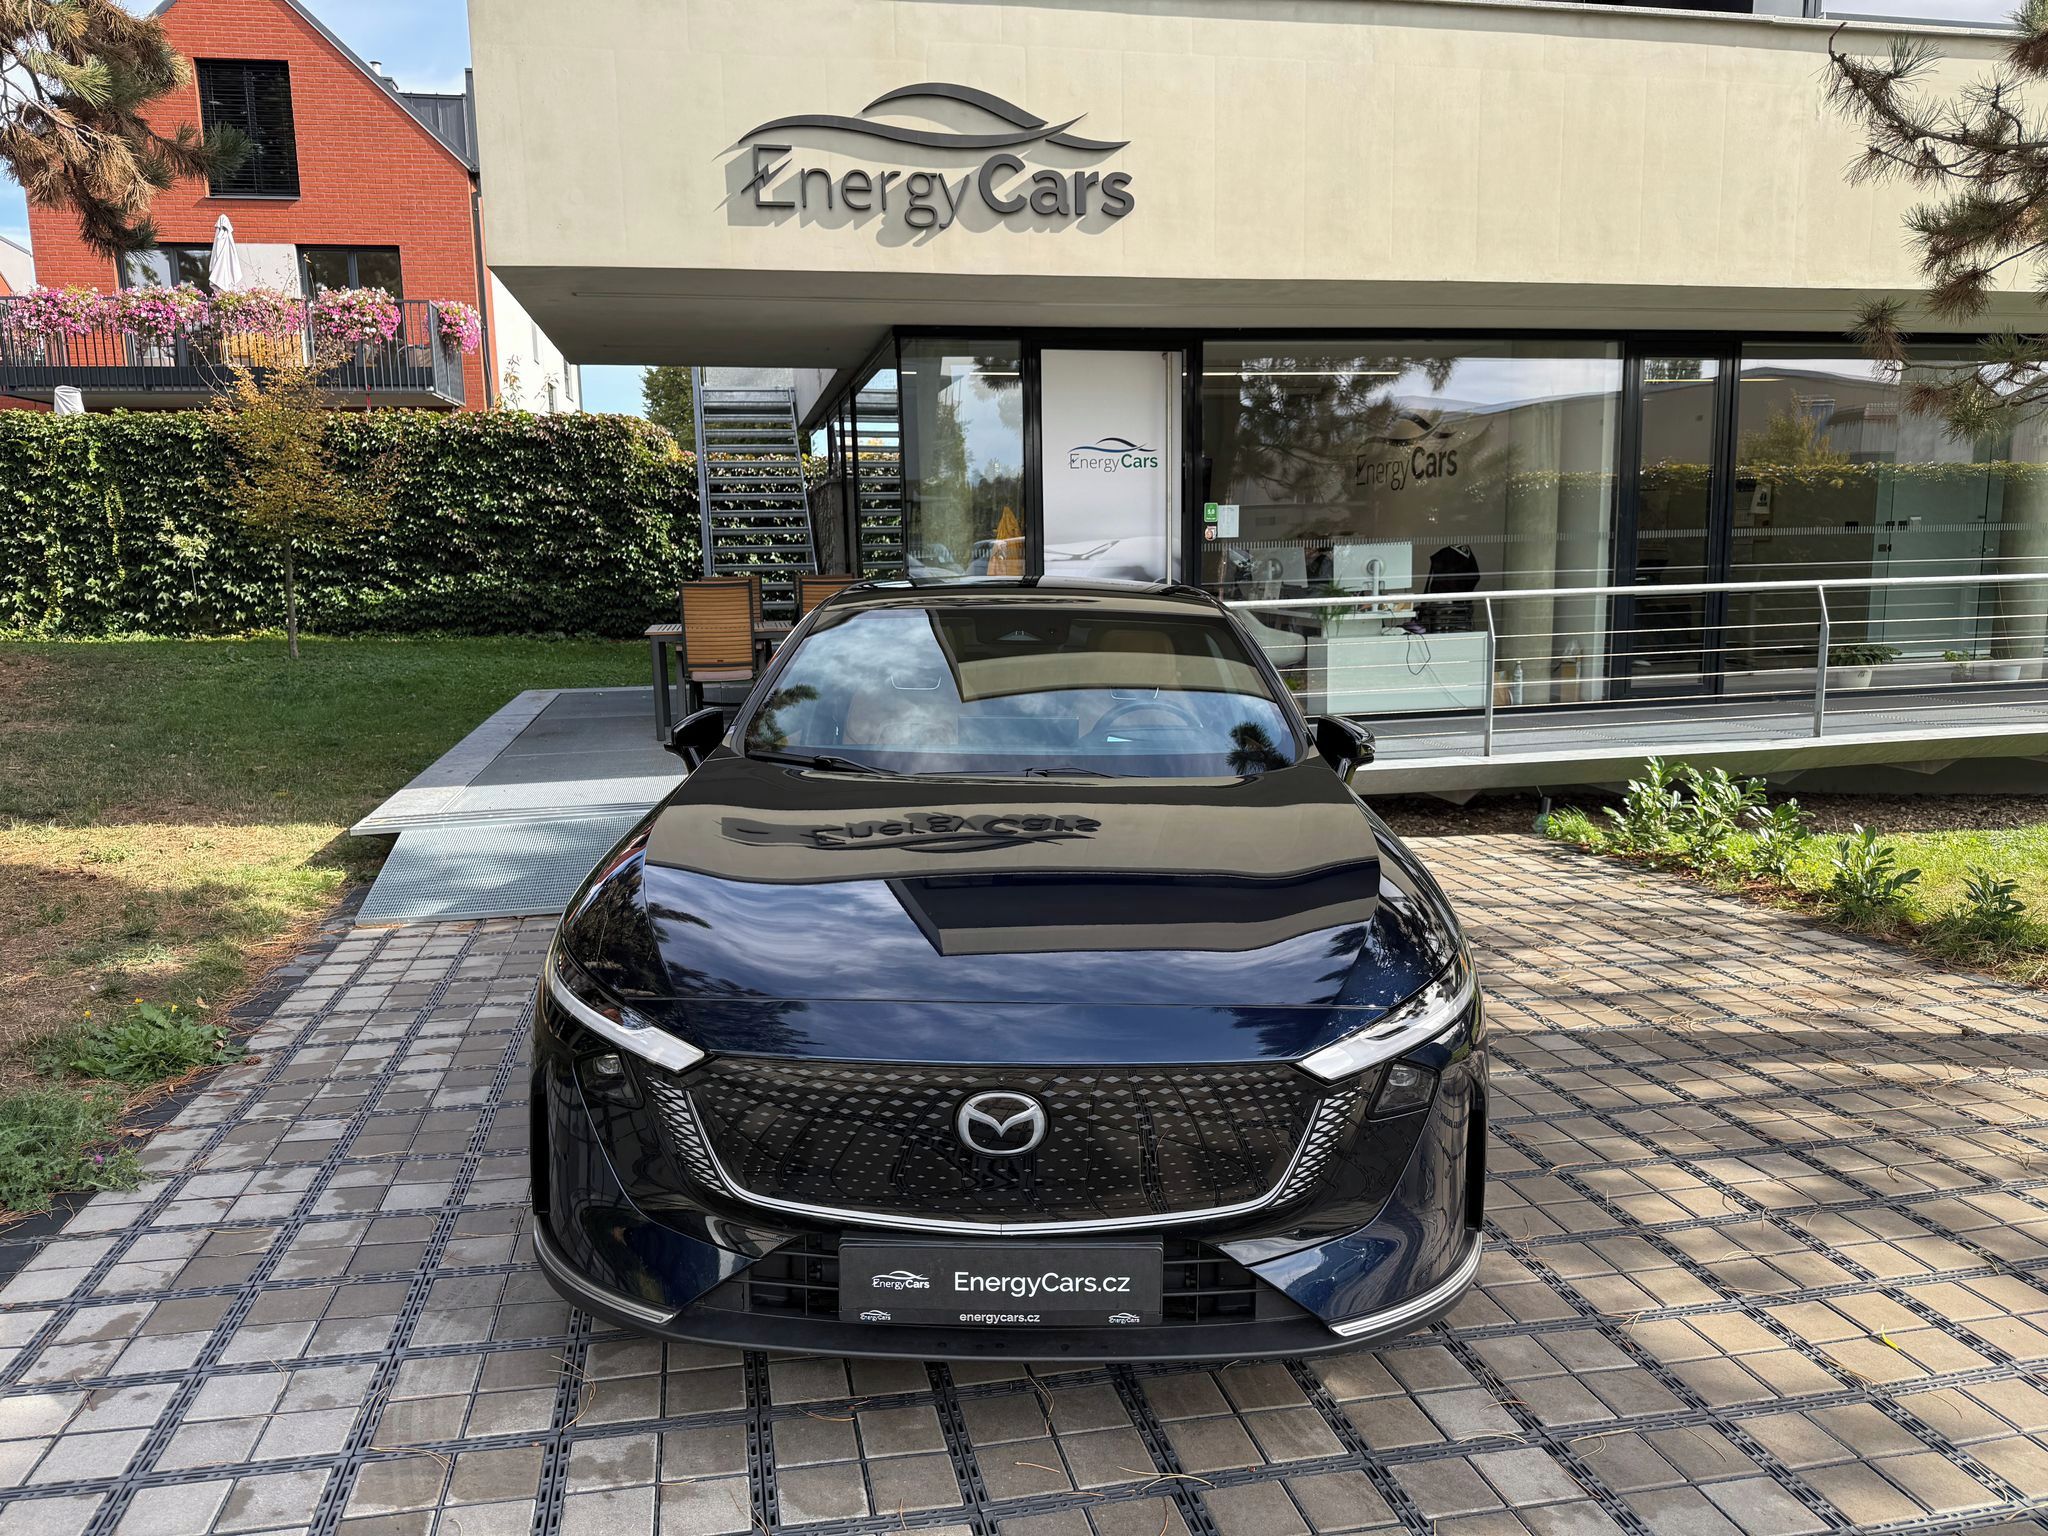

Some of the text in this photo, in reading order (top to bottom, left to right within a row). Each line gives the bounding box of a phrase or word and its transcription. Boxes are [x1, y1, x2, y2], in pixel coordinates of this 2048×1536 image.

[741, 143, 1136, 228] EnergyCars
[1068, 453, 1159, 473] EnergyCars
[1355, 446, 1458, 491] EnergyCars
[872, 1278, 930, 1290] EnergyCars
[954, 1271, 1130, 1297] EnergyCars.cz
[959, 1313, 1040, 1324] energycars.cz
